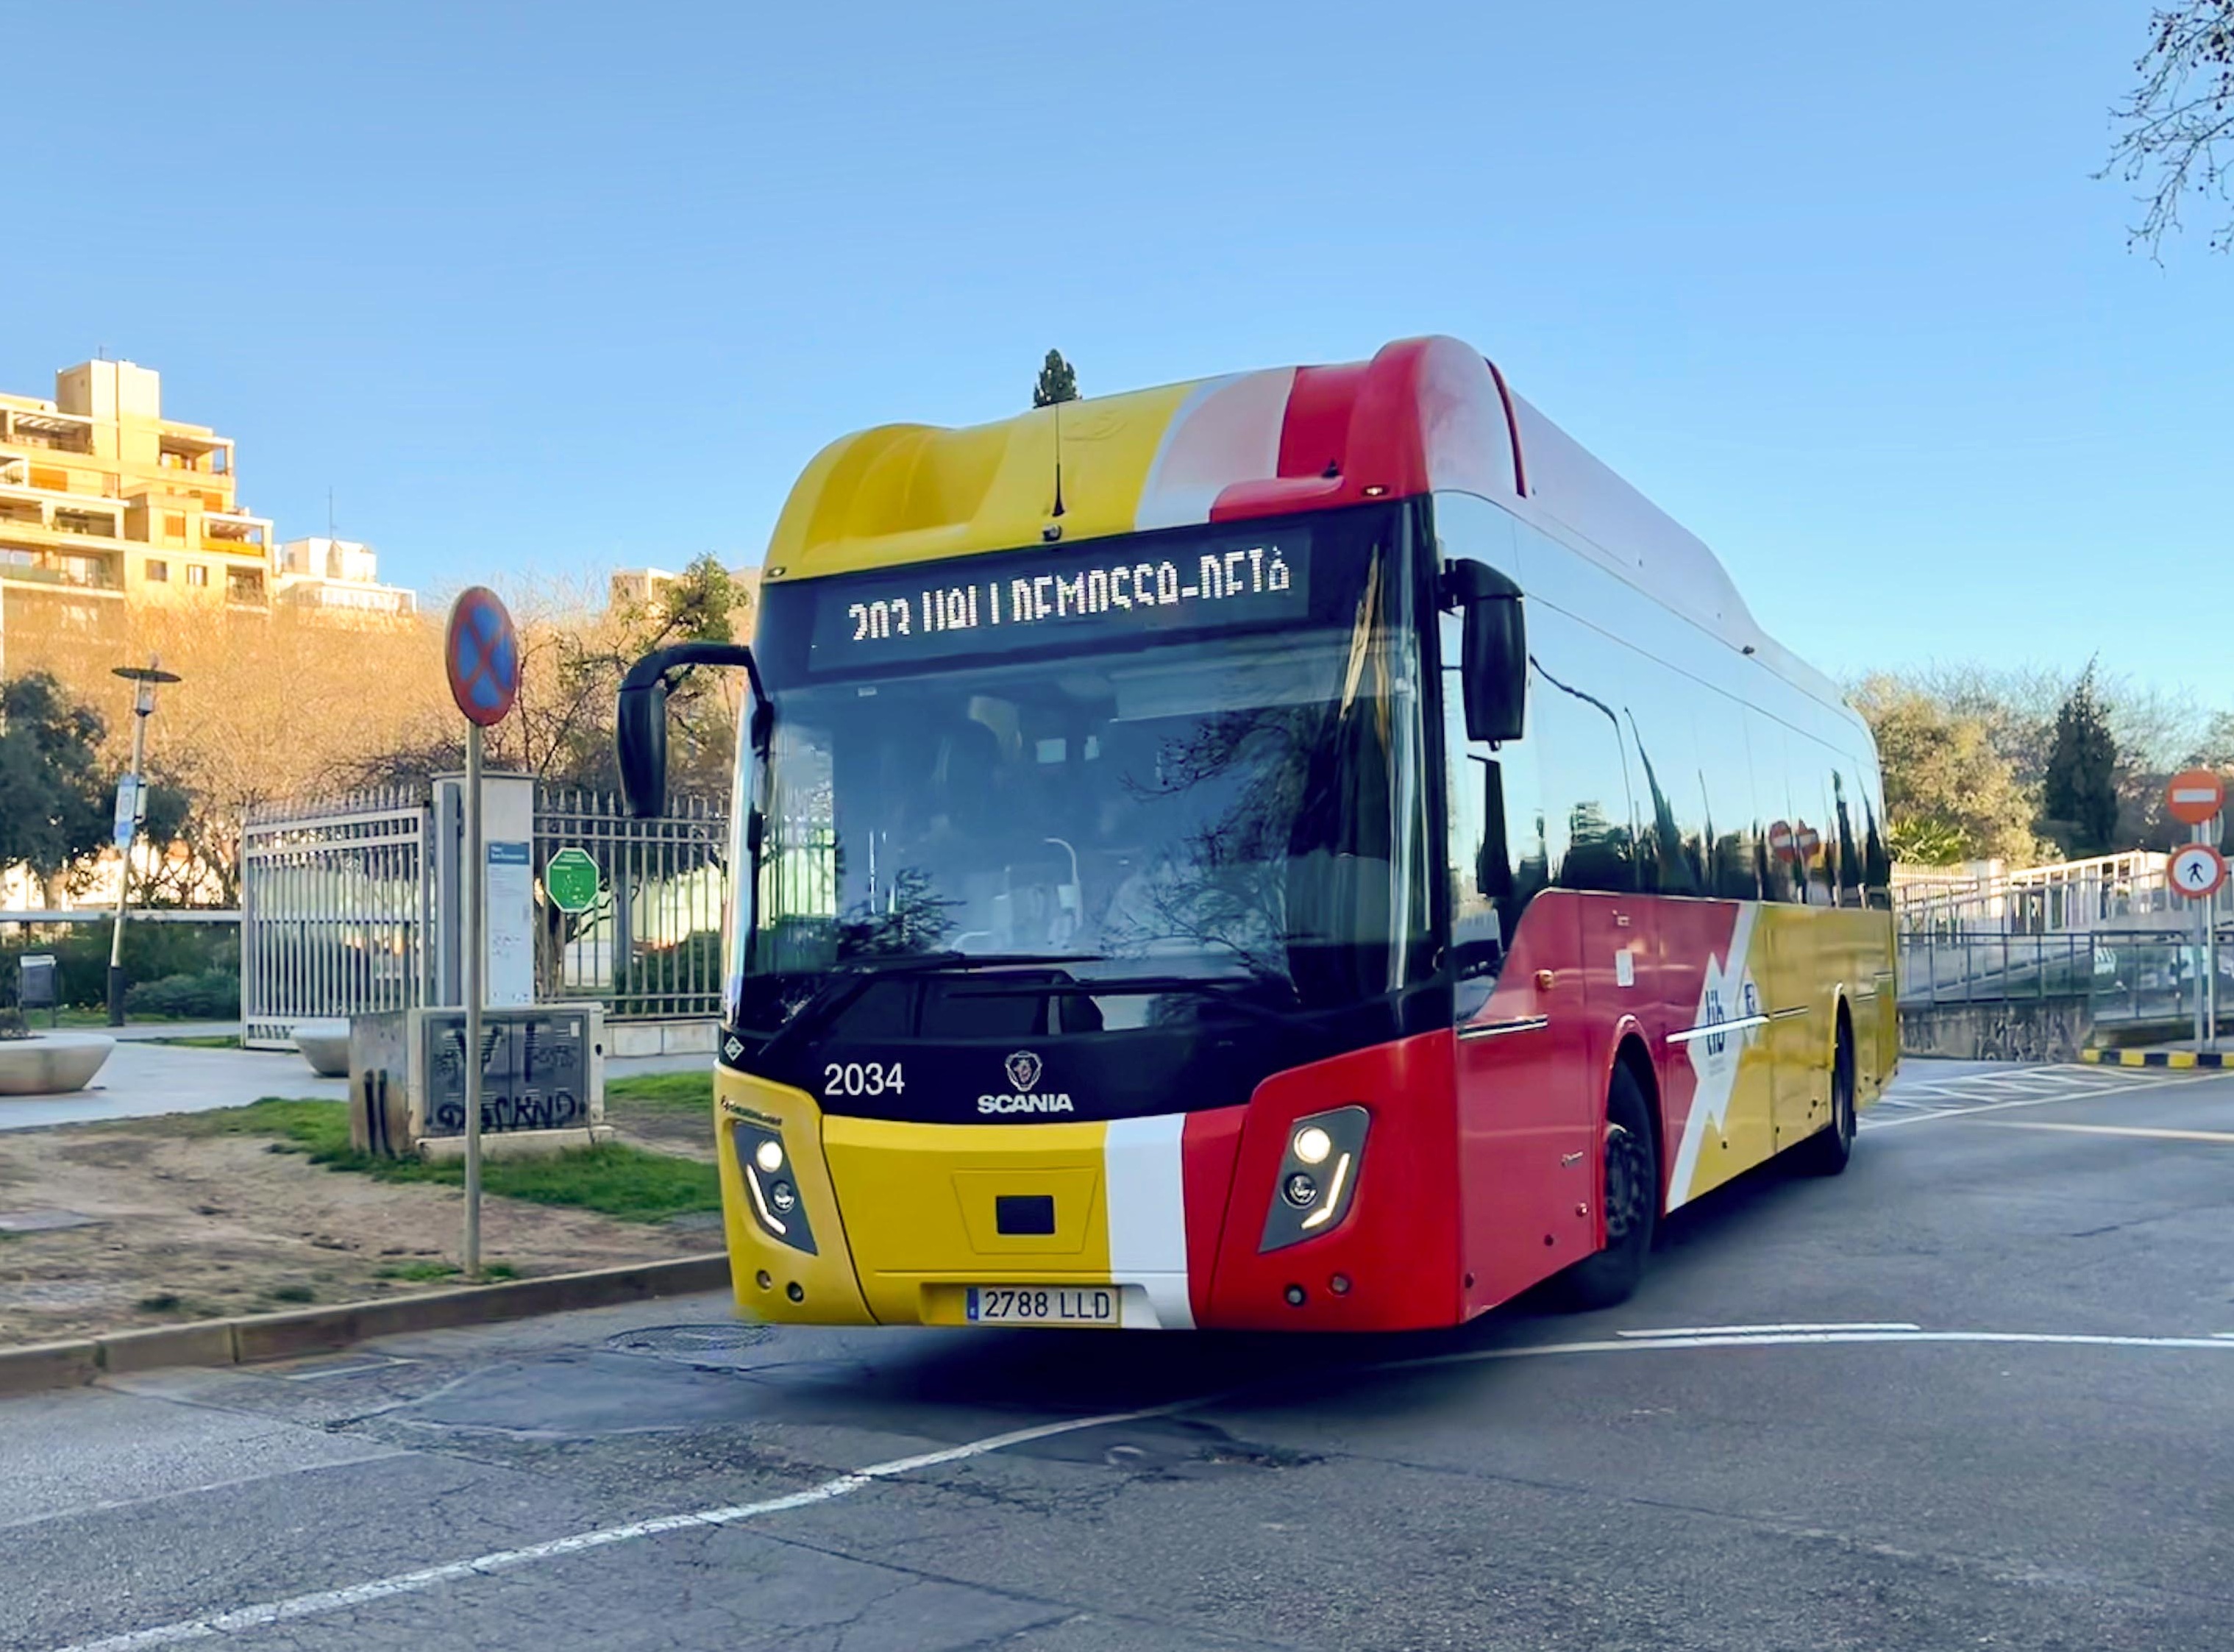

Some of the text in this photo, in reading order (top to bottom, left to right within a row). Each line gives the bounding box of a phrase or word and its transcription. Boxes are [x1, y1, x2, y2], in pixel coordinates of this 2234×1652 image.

[823, 1061, 906, 1097] 2034
[976, 1093, 1075, 1114] SCANIA
[984, 1291, 1110, 1319] 2788 LLD
